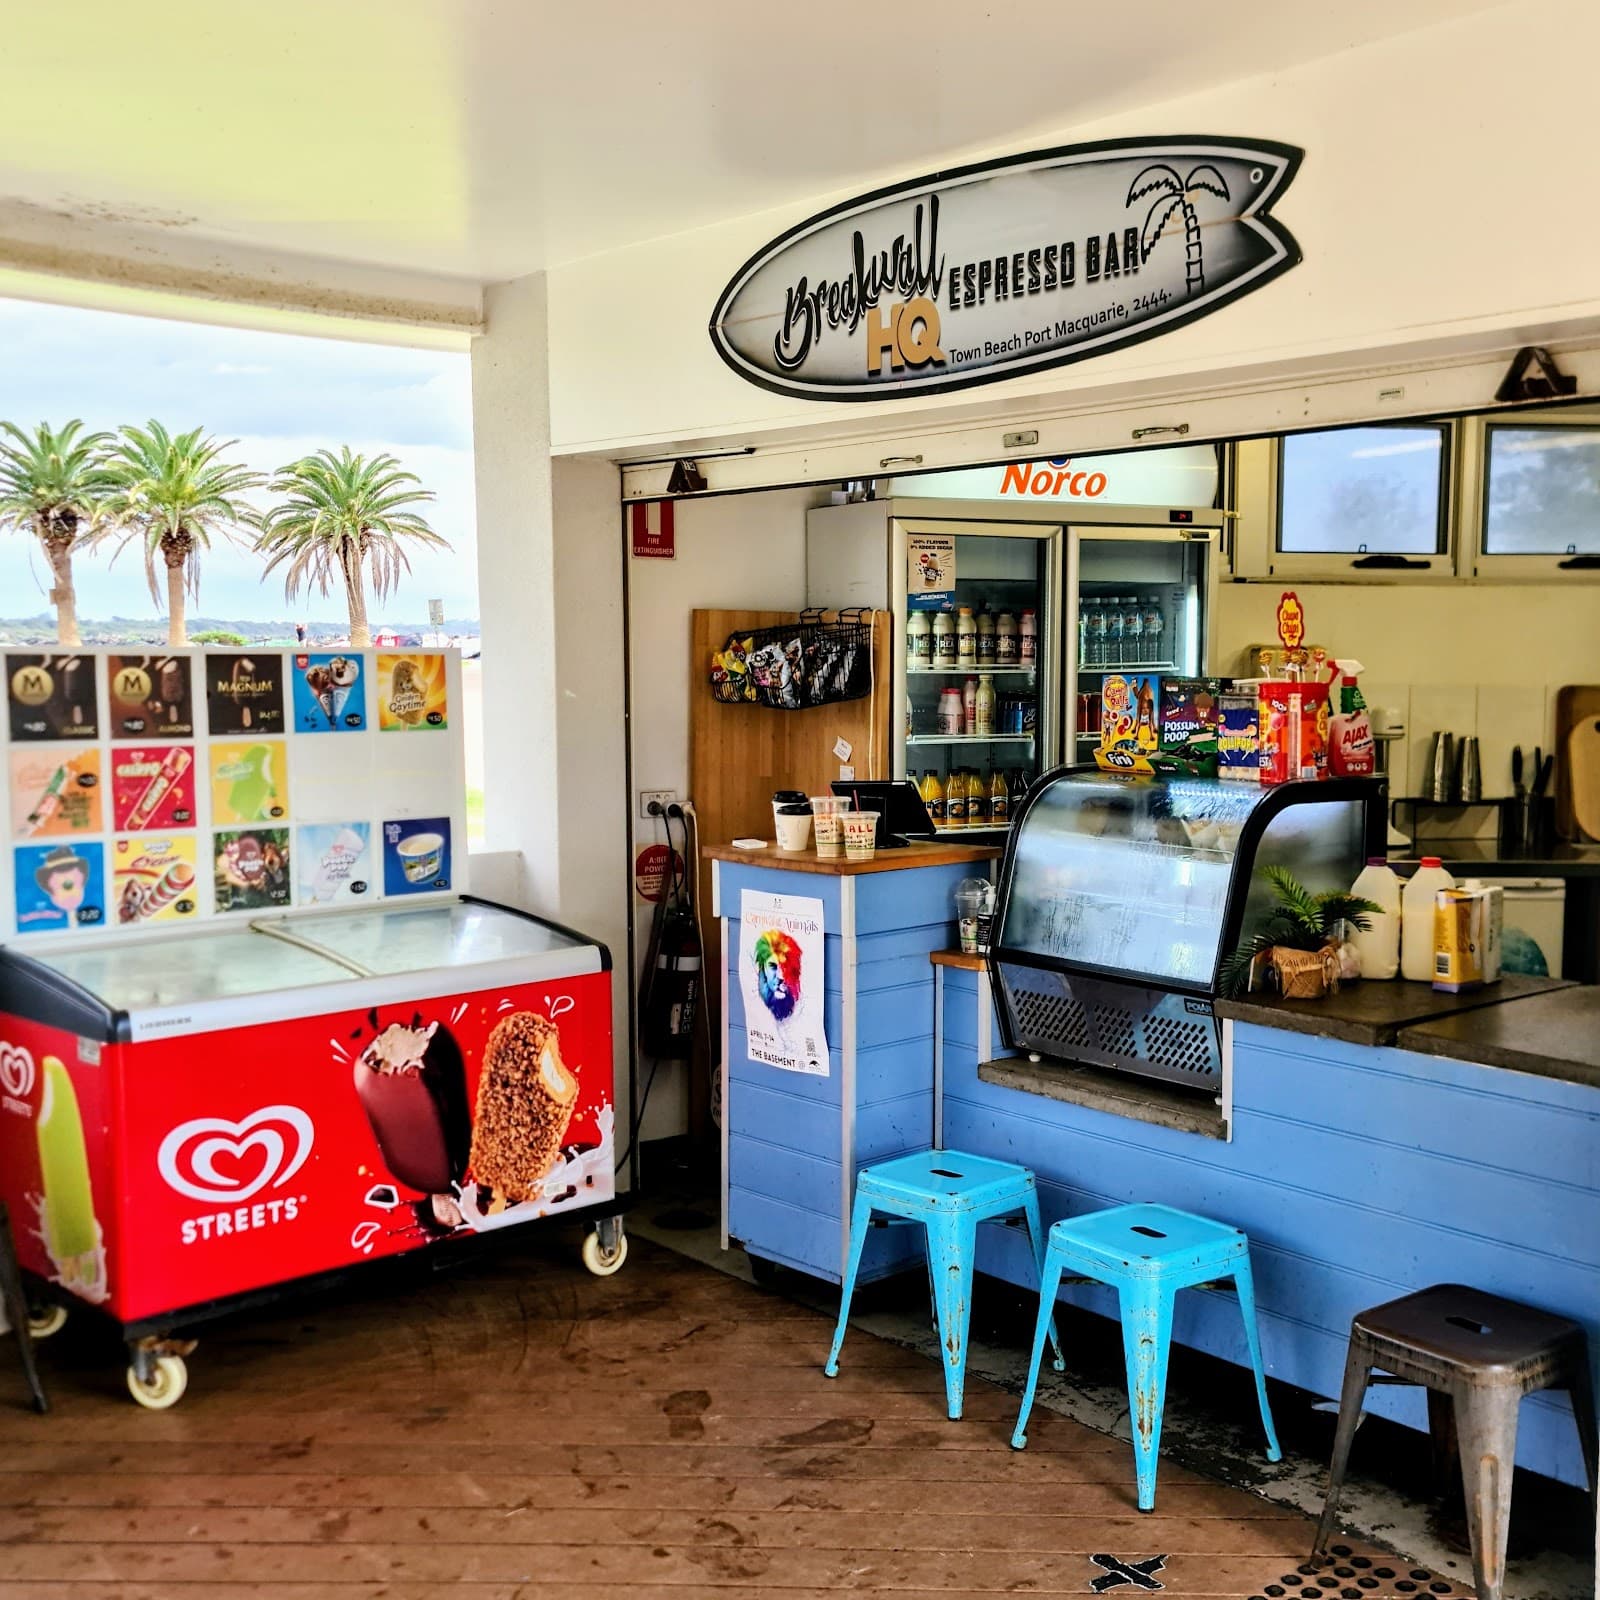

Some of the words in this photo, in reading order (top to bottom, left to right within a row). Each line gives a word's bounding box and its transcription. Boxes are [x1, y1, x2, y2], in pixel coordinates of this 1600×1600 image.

[948, 240, 1076, 309] ESPRESSO
[1086, 225, 1140, 277] BAR
[775, 193, 947, 371] Breakwall
[867, 296, 946, 374] HQ
[949, 344, 983, 365] Town
[984, 334, 1023, 359] Beach
[1025, 328, 1053, 351] Port
[1054, 299, 1131, 342] Macquarie,
[1000, 462, 1107, 497] Norco
[634, 546, 674, 555] EXTINGUISHER
[647, 537, 660, 545] FIRE
[21, 674, 43, 695] M
[122, 674, 143, 692] M
[217, 680, 273, 693] MAGNUM
[389, 700, 427, 713] Gaytime
[1164, 721, 1200, 732] POSSUM
[1342, 724, 1368, 746] AJAX
[1164, 731, 1189, 743] POOP
[1107, 752, 1134, 766] Fini
[750, 1029, 763, 1039] APRIL
[752, 1048, 763, 1058] THE
[764, 1052, 796, 1068] BASEMENT
[181, 1198, 298, 1245] STREETS
